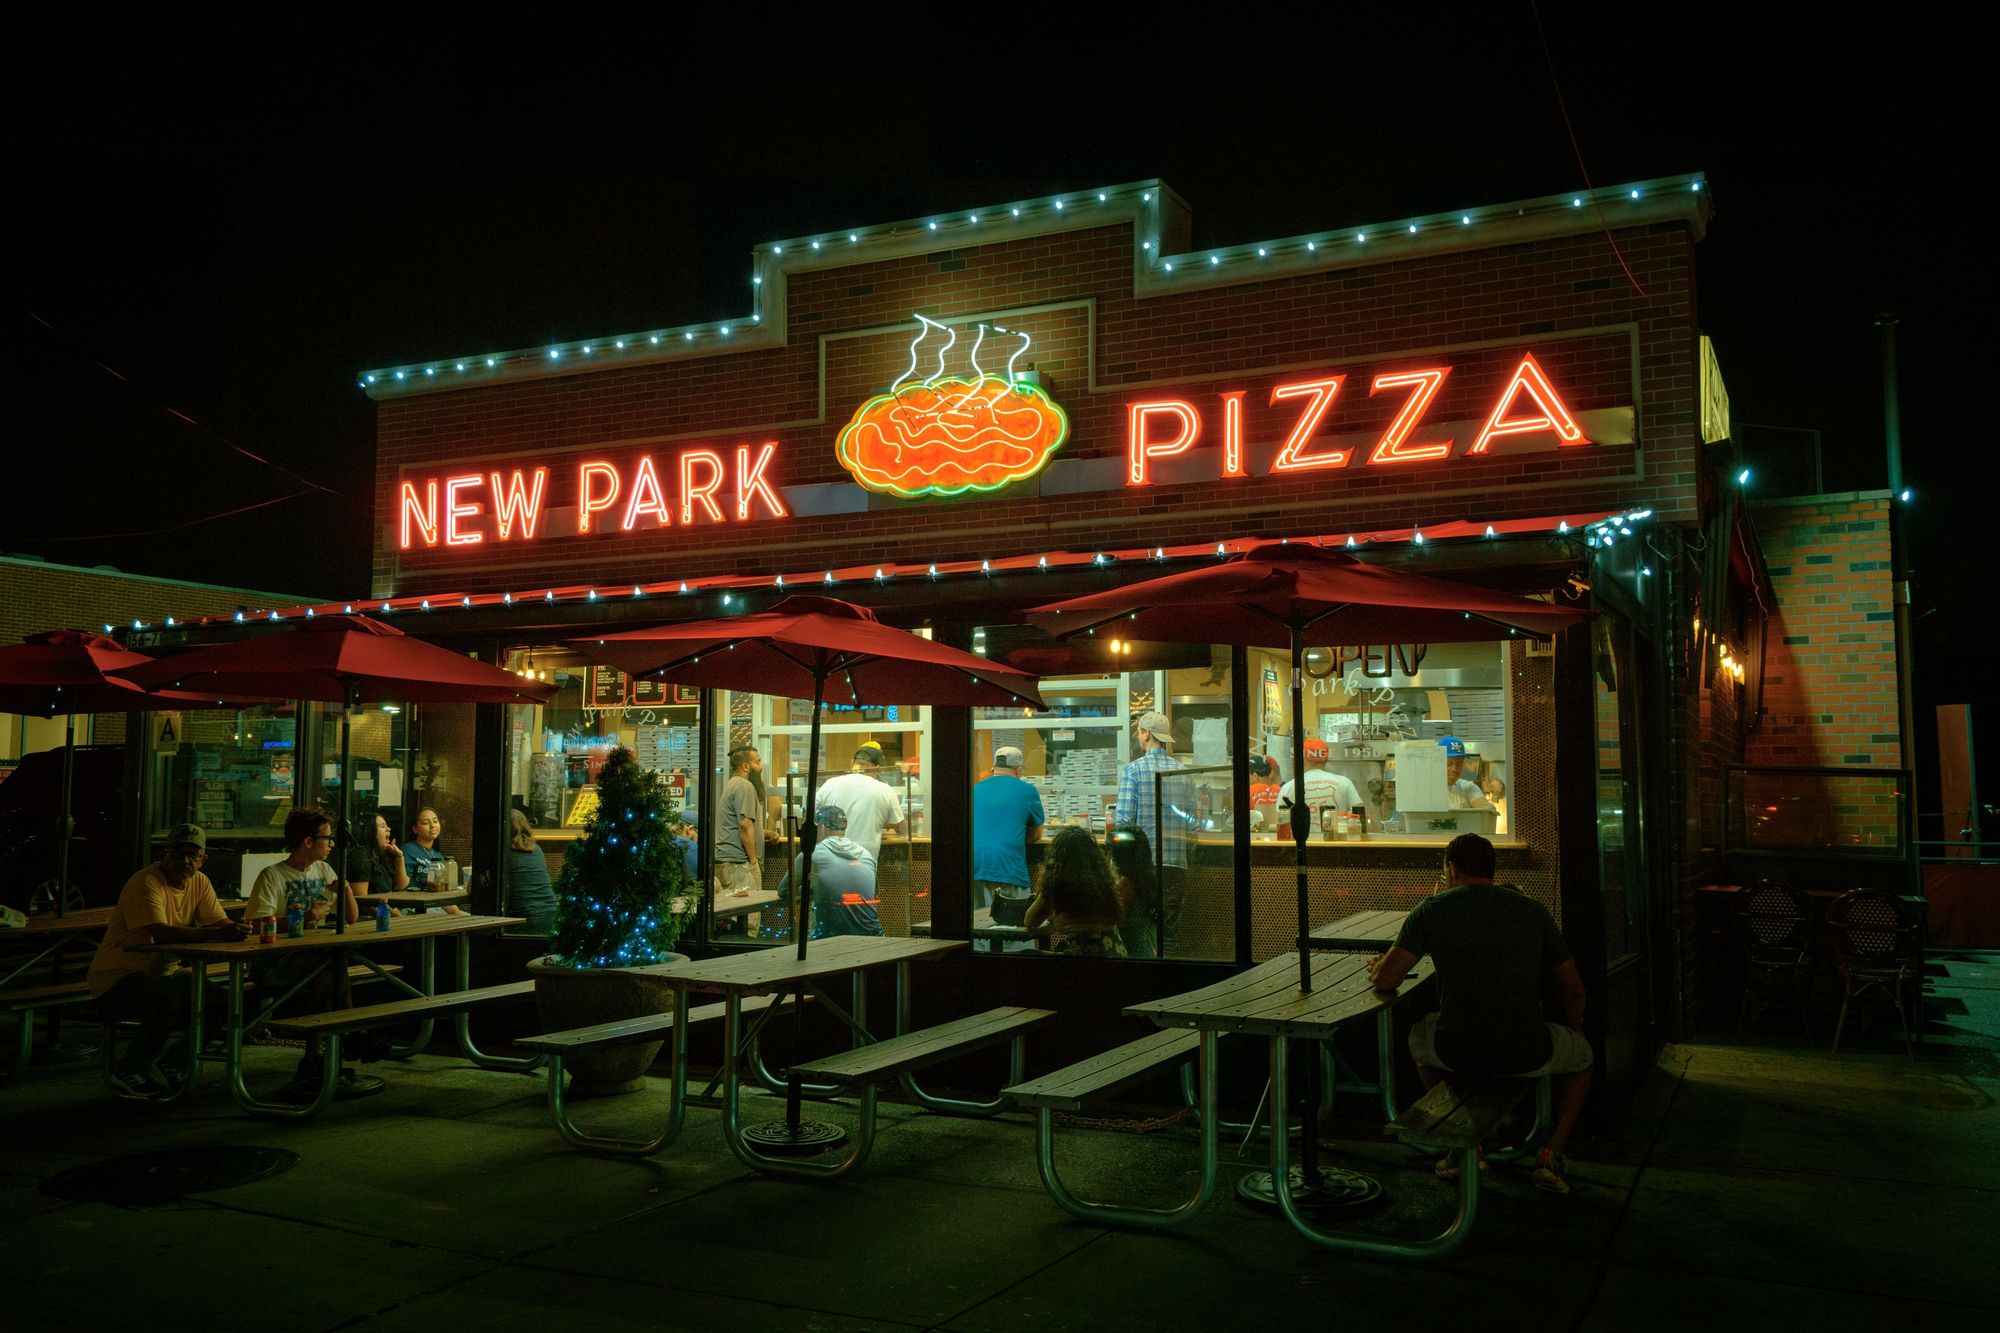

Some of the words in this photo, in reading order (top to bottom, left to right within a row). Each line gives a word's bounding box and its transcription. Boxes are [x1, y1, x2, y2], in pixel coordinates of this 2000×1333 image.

[400, 466, 550, 550] NEW
[578, 441, 788, 533] PARK
[1124, 351, 1594, 487] PIZZA
[583, 694, 634, 724] Park
[160, 717, 176, 741] A
[583, 760, 606, 769] SIN
[1344, 747, 1381, 758] 1956
